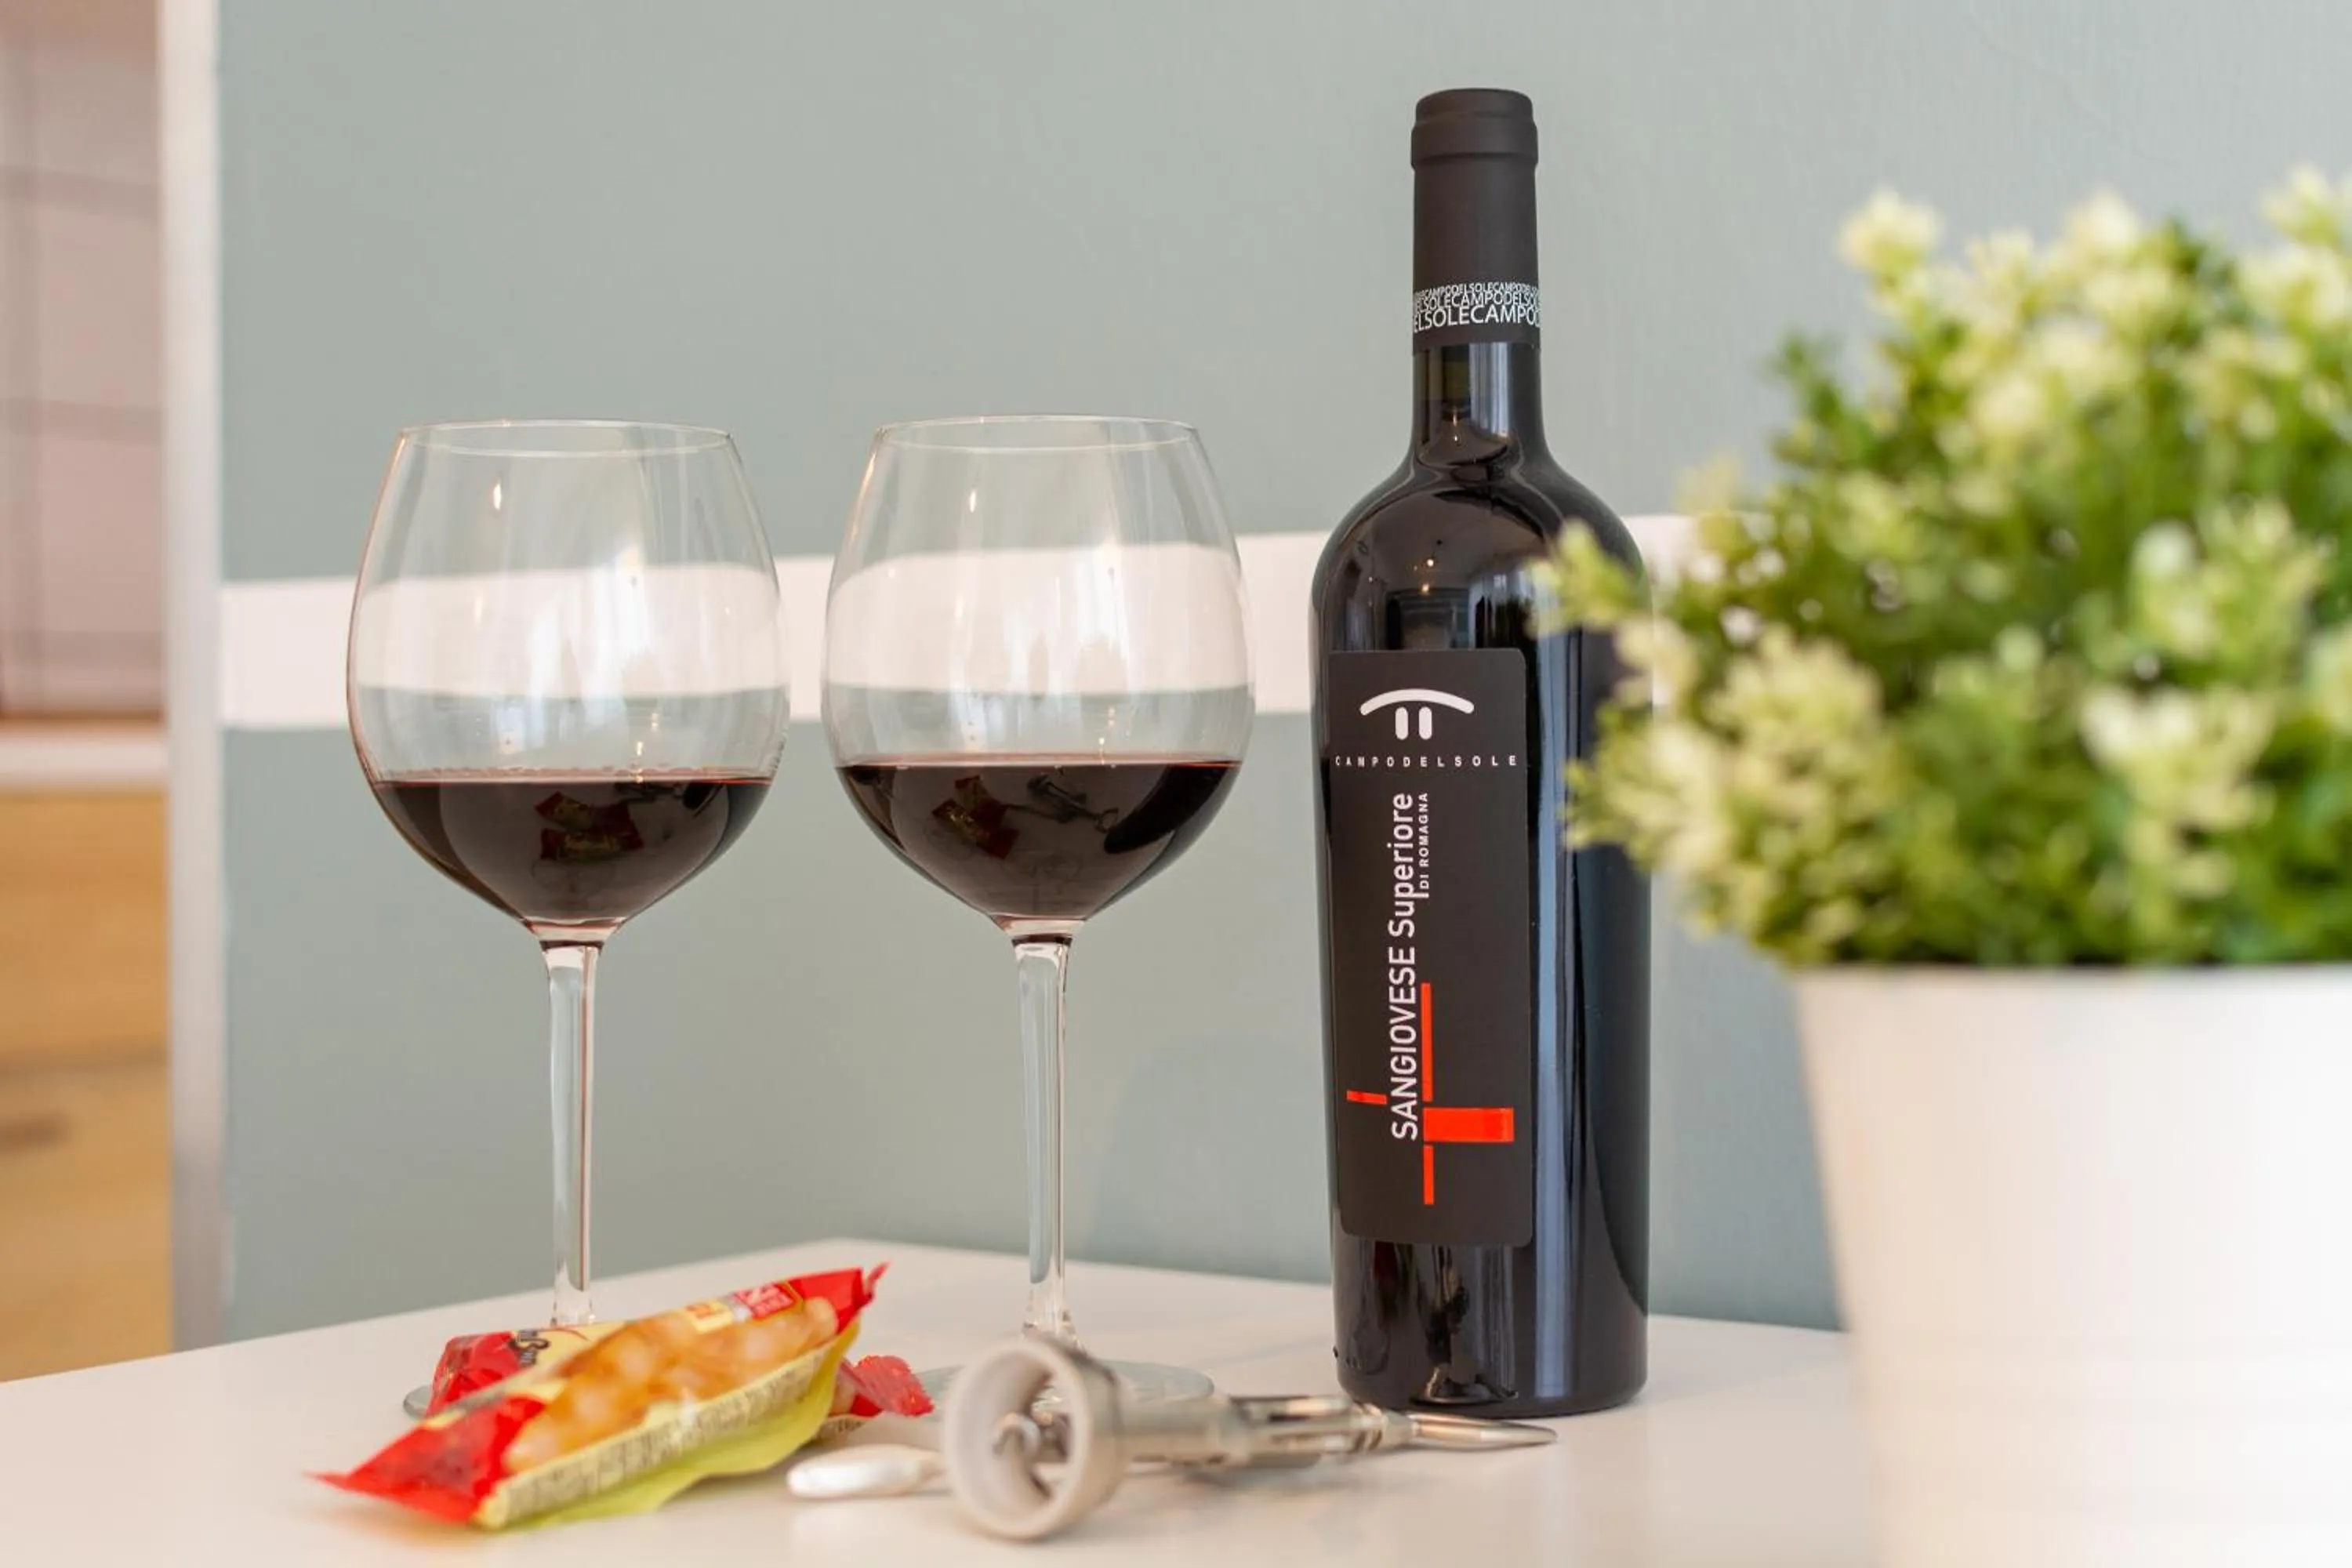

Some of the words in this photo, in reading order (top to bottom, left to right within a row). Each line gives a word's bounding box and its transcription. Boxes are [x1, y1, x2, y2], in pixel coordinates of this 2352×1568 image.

[1335, 755, 1517, 768] CAMPODELSOLE
[1386, 793, 1429, 938] Superiore
[1418, 793, 1429, 868] ROMAGNA
[1420, 874, 1429, 890] DI
[1388, 946, 1418, 1141] SANGIOVESE
